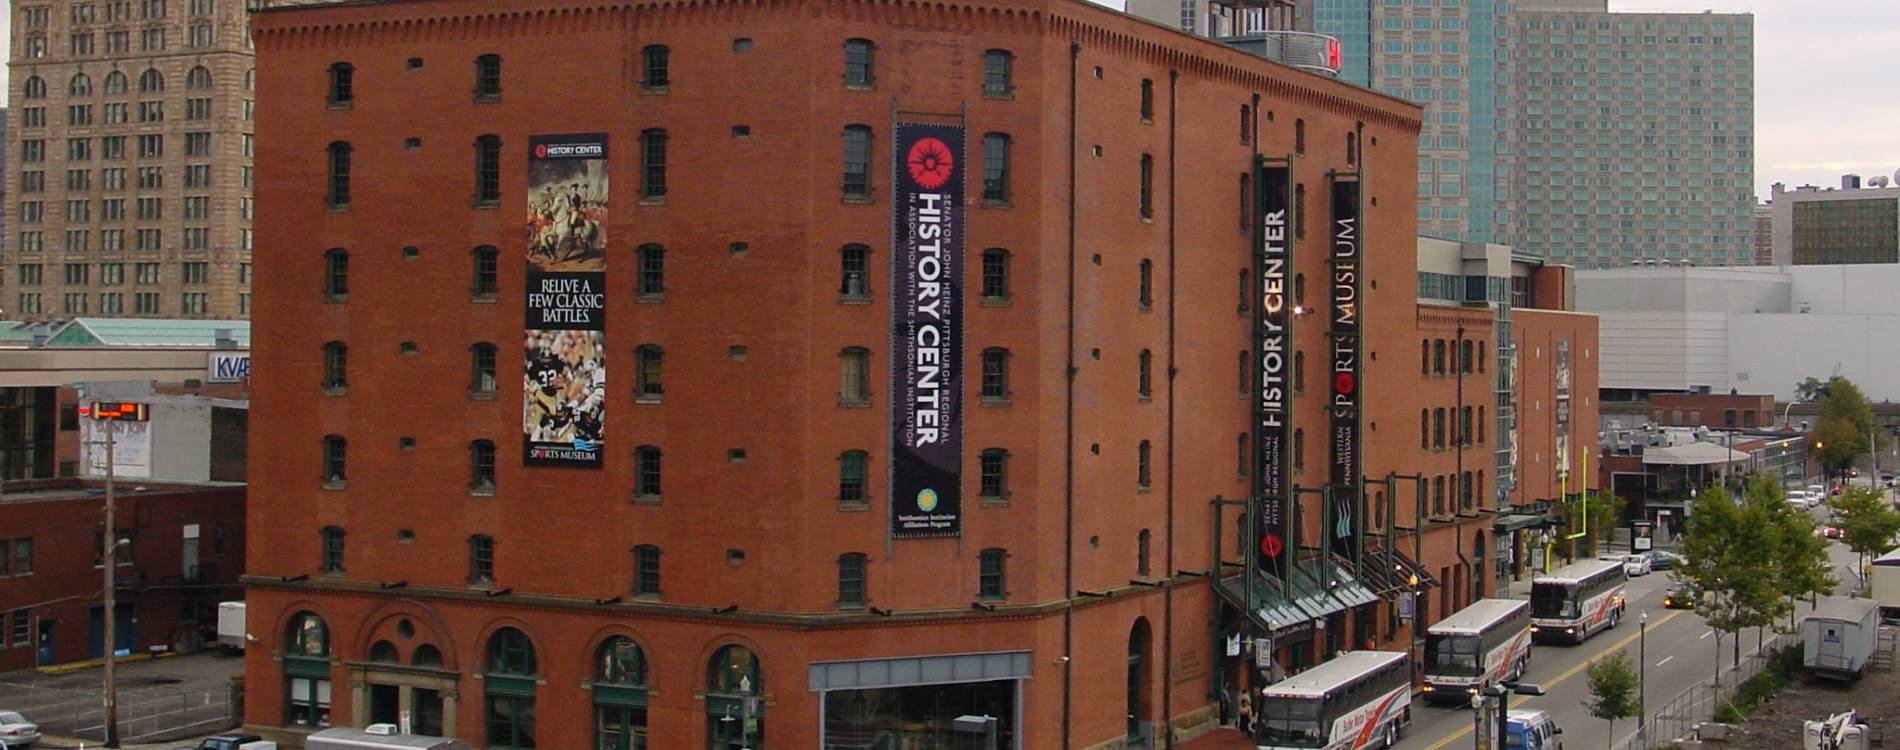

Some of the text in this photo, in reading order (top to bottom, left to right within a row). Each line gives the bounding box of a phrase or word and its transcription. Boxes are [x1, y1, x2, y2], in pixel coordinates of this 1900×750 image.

[1327, 38, 1341, 70] H
[547, 146, 574, 155] HISTORY
[575, 145, 602, 154] CENTER
[529, 293, 604, 309] FEW CLASSIC
[542, 279, 591, 293] RELIVE A
[906, 192, 916, 447] IN ASSOCIATION WITH THE SMITHSONIAN INSTITUTION
[916, 193, 940, 448] HISTORY CENTER
[941, 193, 951, 445] SENATOR JOHN HEINZ PITTSBURGH REGIONAL
[1263, 209, 1285, 427] HISTORY CENTER
[560, 451, 596, 460] MUSEUM
[1336, 426, 1344, 465] WESTERN
[1344, 426, 1352, 486] PENNSYLVANIA
